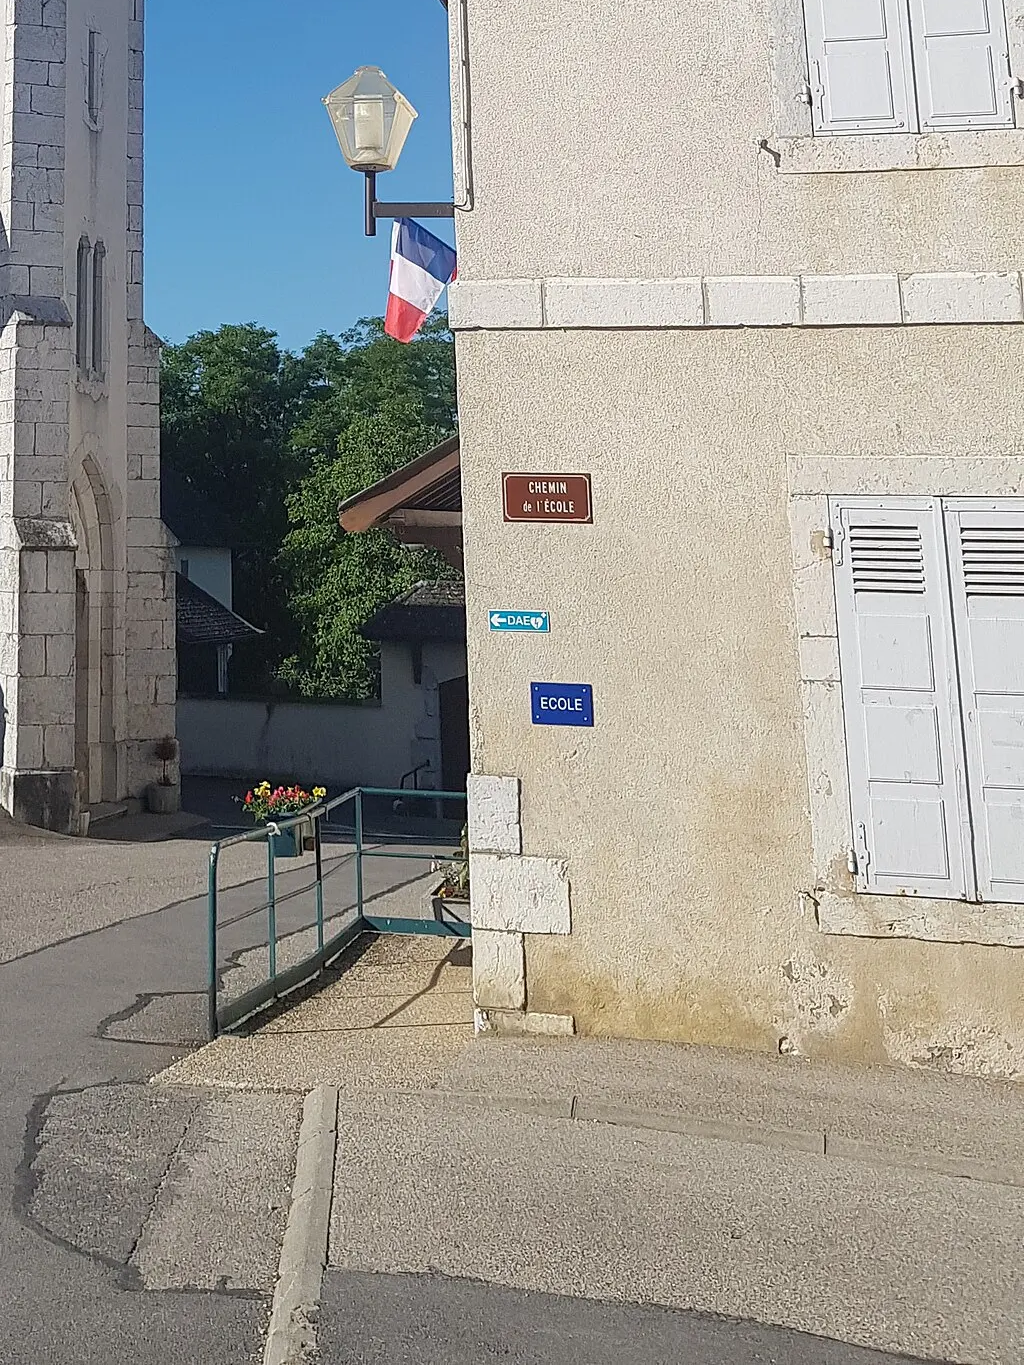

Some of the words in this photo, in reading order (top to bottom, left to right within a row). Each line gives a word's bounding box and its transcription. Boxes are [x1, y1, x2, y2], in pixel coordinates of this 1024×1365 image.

[528, 481, 567, 494] CHEMIN
[522, 501, 532, 512] de
[537, 498, 575, 513] l'ÉCOLE
[507, 615, 531, 626] DAE
[540, 696, 583, 711] ECOLE
